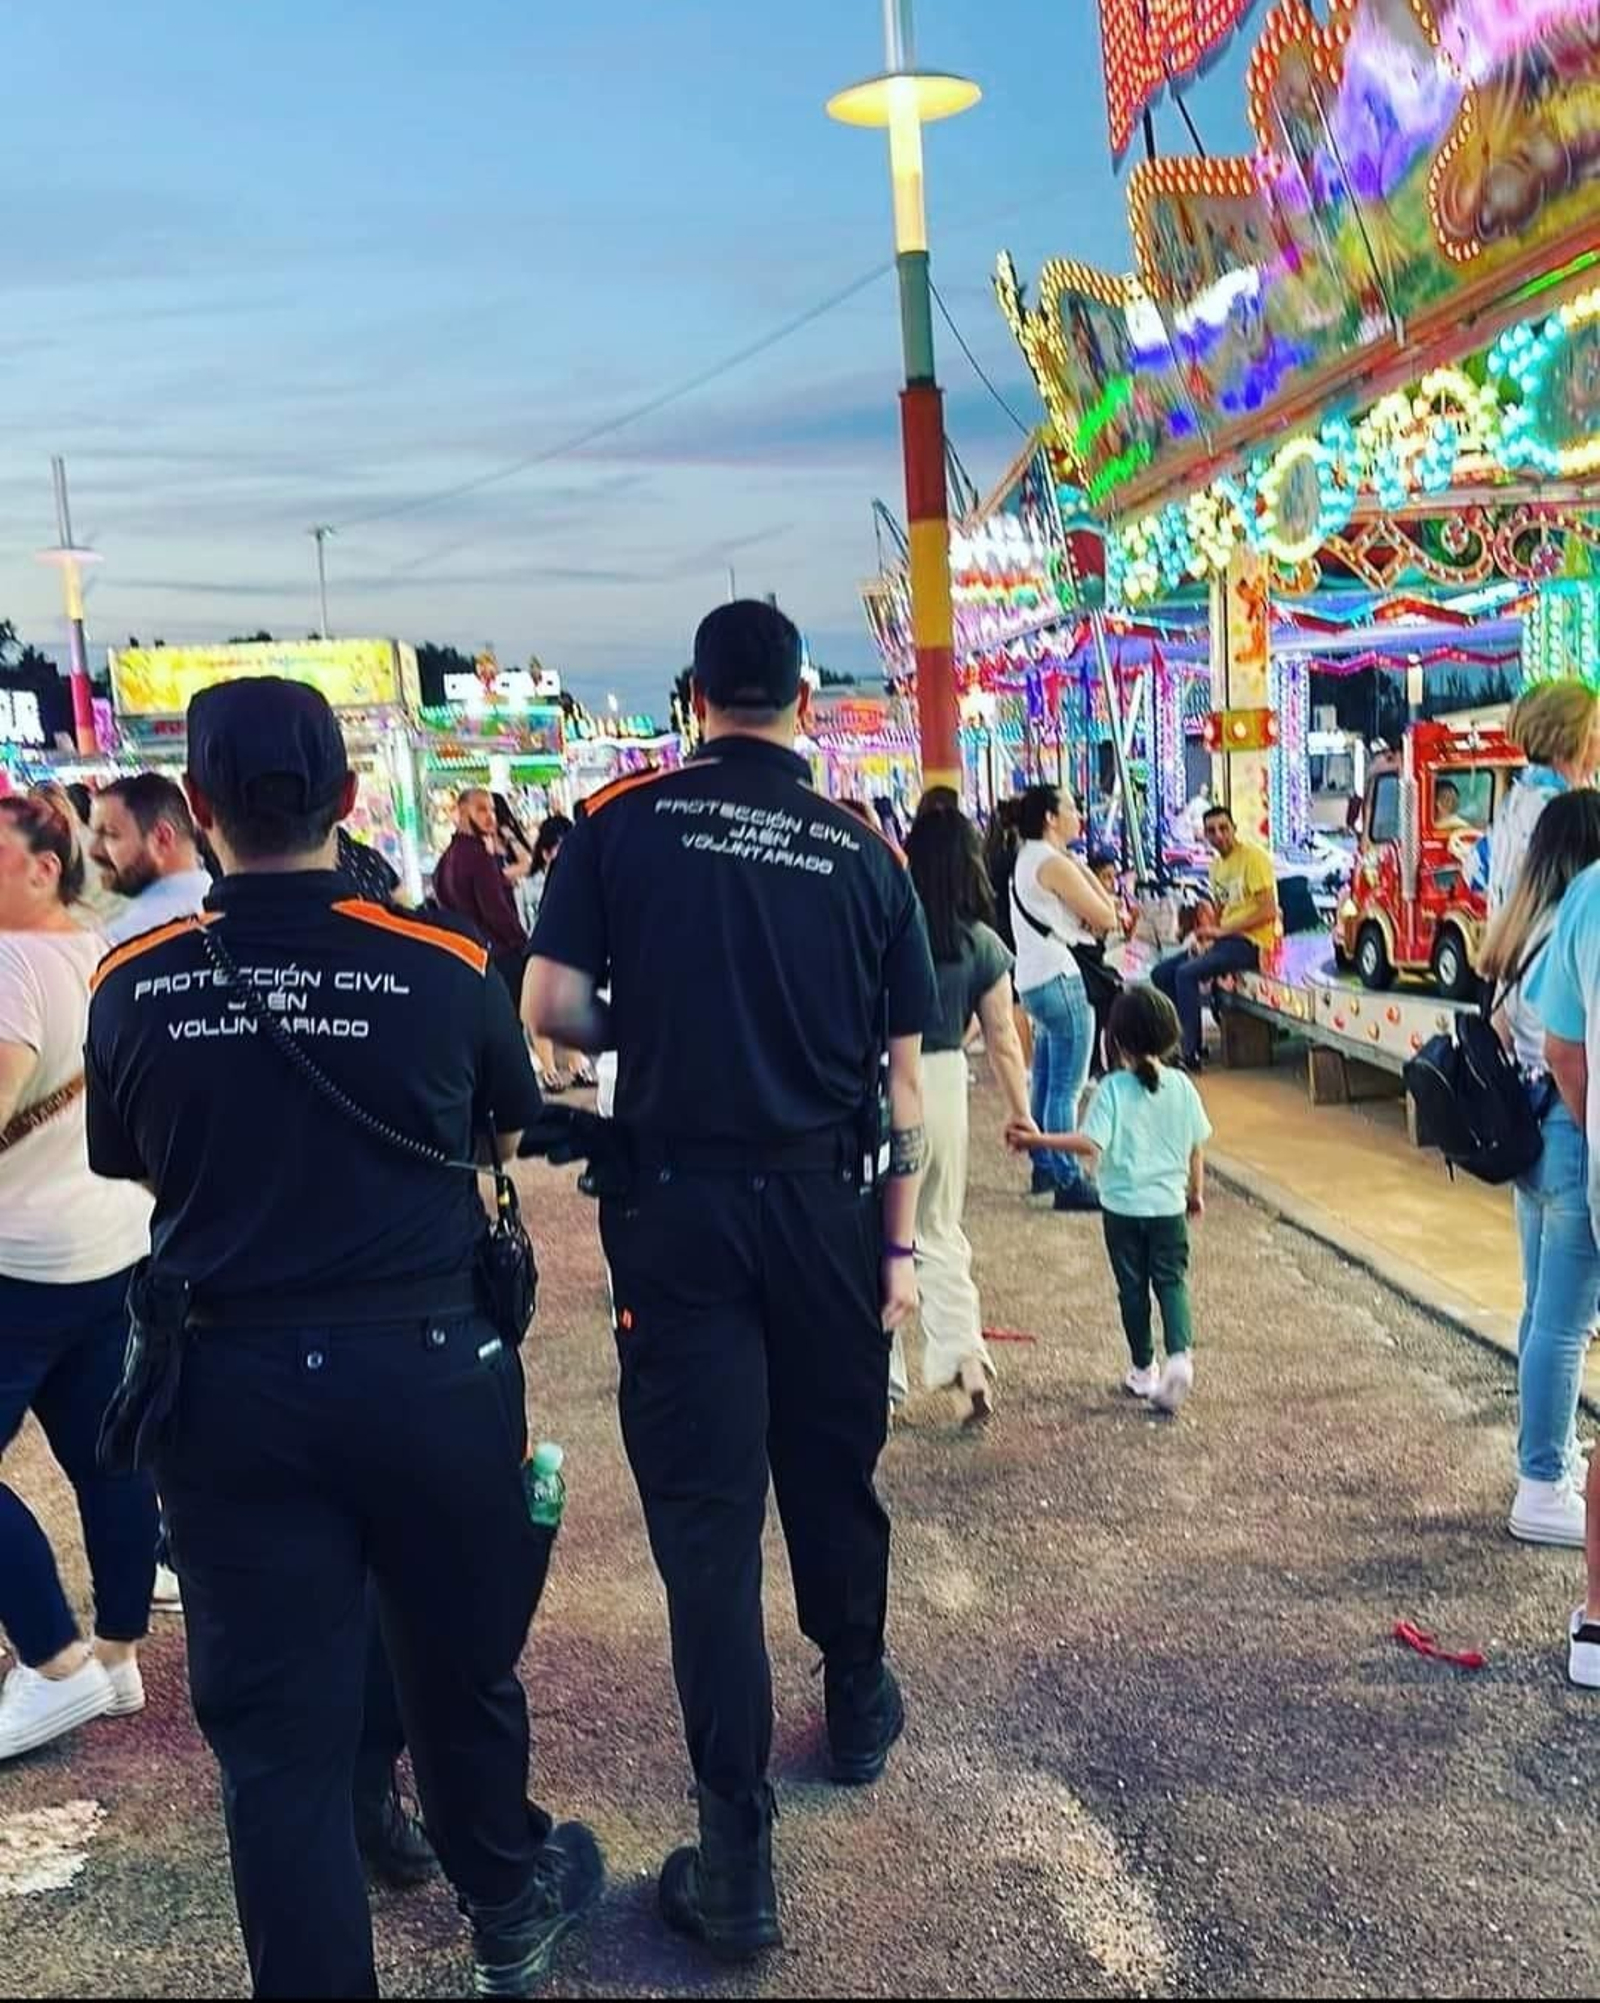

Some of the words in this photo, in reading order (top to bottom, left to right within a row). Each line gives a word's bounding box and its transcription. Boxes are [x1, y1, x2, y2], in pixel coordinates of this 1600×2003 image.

[654, 799, 802, 834] PROTECCIÓN
[809, 821, 860, 851] CIVIL
[681, 832, 834, 875] VOLUNTARIADO
[334, 971, 410, 994] CIVIL
[168, 1016, 370, 1040] VOLUNARIADO
